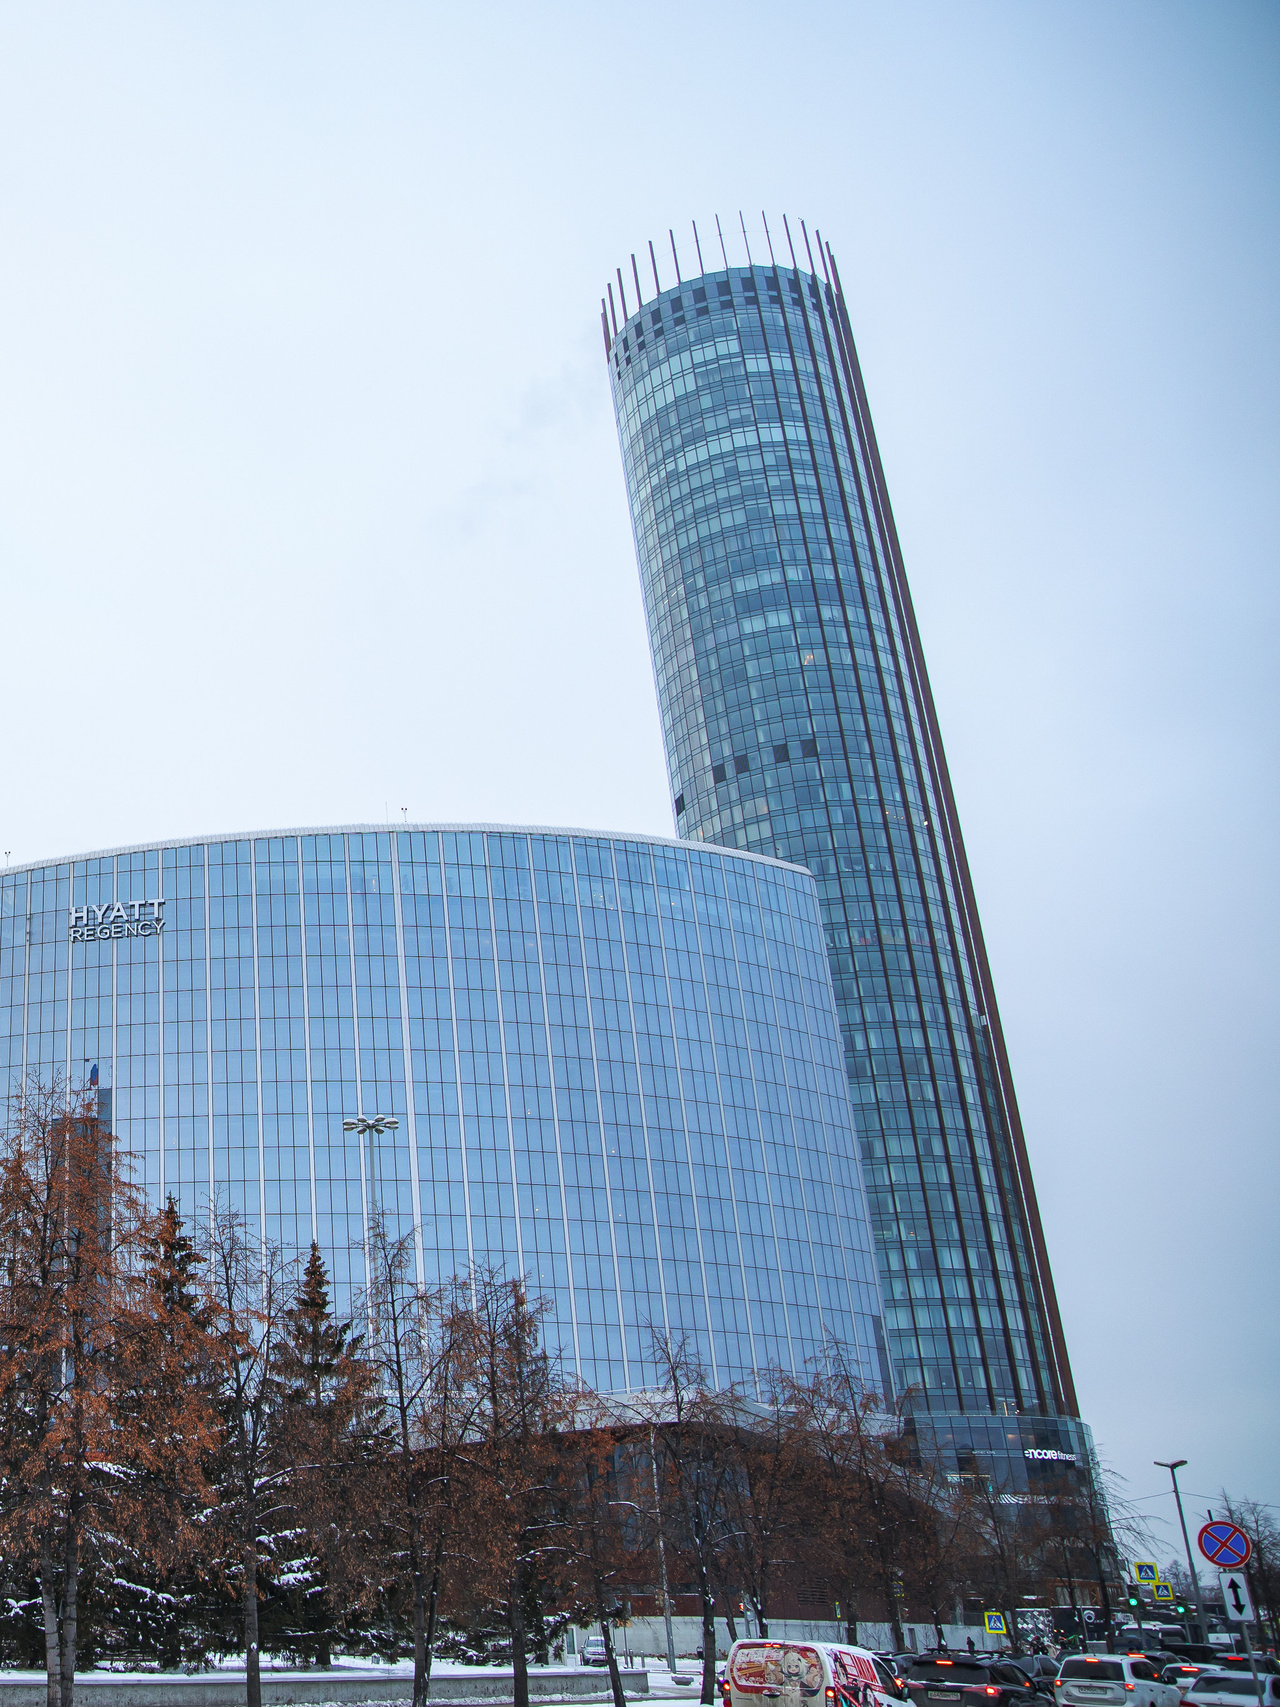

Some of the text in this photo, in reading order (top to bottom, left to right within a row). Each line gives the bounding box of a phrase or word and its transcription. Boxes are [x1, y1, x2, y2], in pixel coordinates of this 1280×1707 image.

[70, 898, 165, 926] HYATT
[70, 919, 166, 942] REGENCY
[1023, 1448, 1077, 1461] encore fitness
